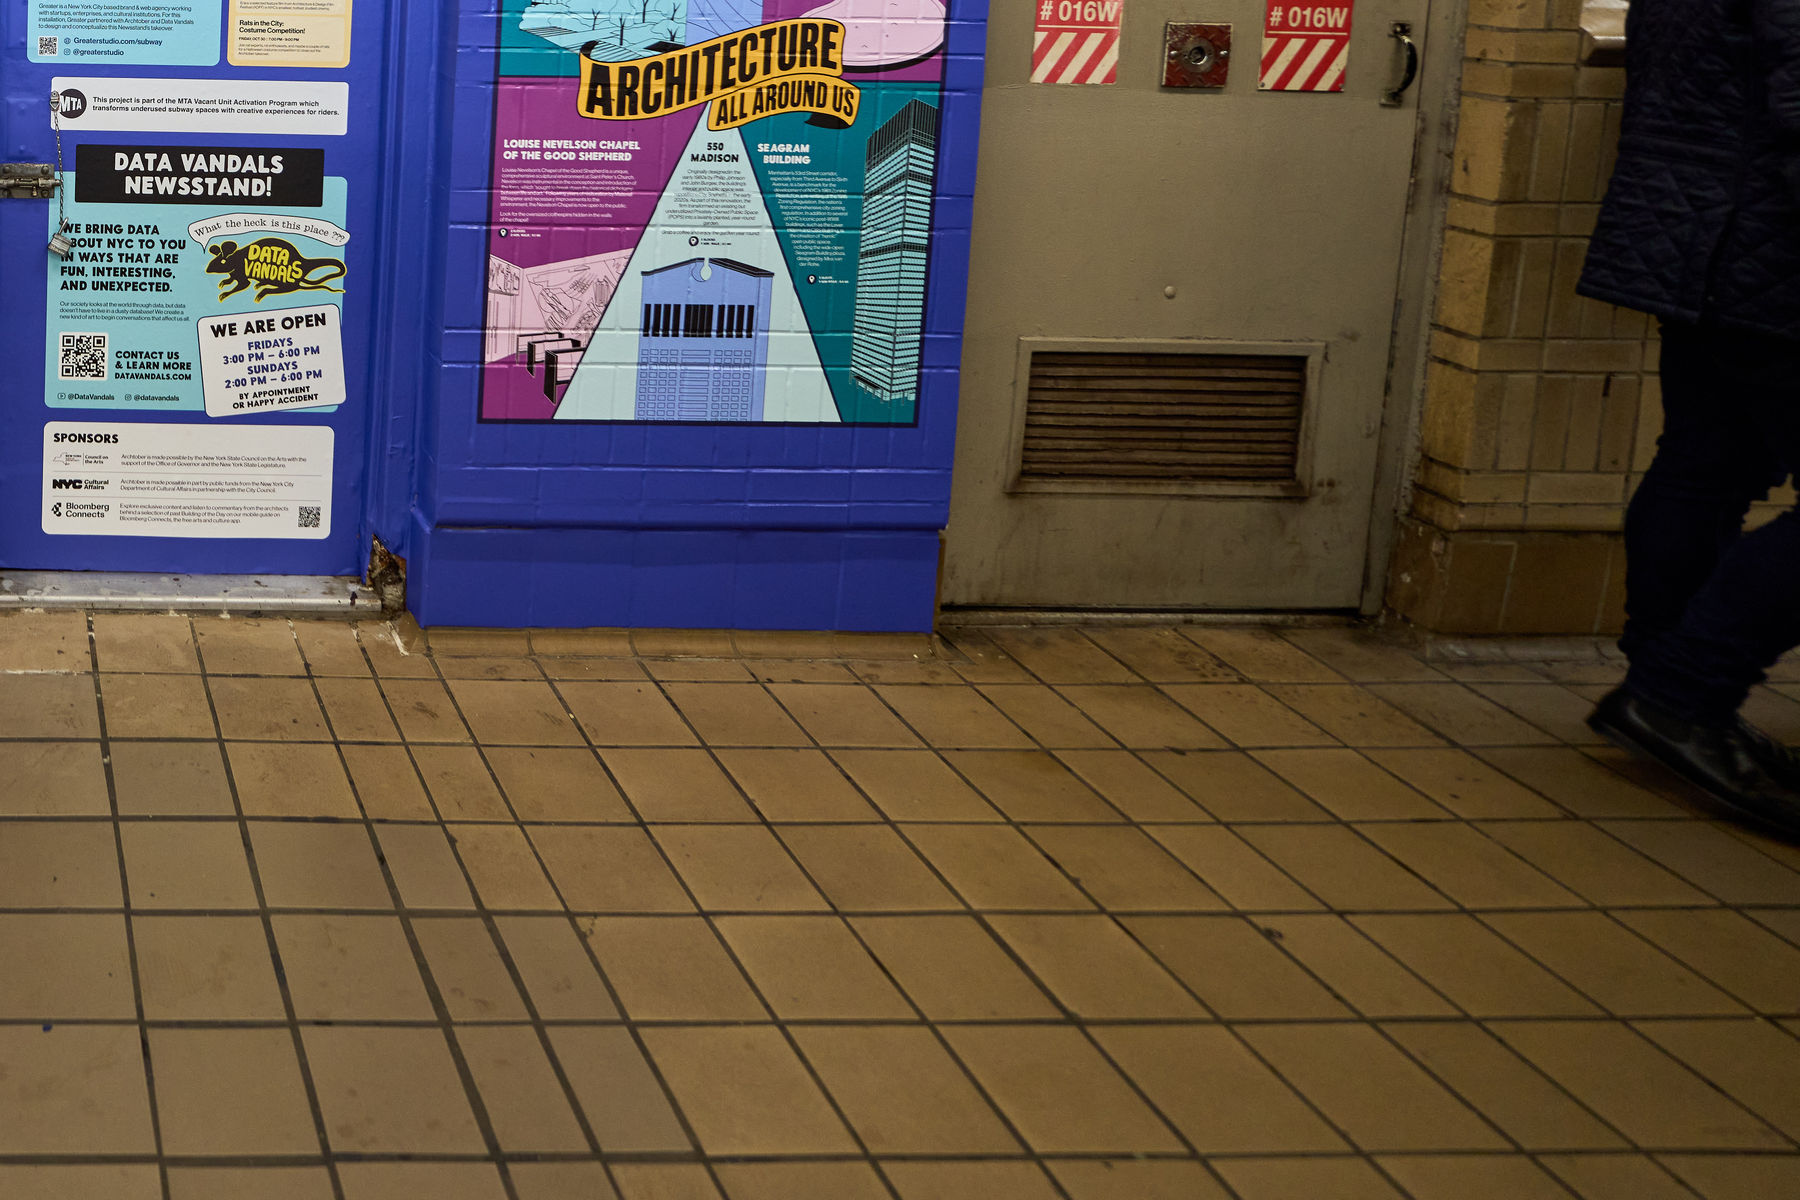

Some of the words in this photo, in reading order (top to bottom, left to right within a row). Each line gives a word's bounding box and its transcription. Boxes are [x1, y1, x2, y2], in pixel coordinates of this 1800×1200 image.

[1040, 0, 1054, 21] #
[1057, 0, 1118, 23] 016W
[1269, 6, 1283, 26] #
[1287, 6, 1348, 28] 016W
[584, 24, 839, 118] ARCHITECTURE
[714, 94, 750, 127] ALL
[751, 80, 827, 118] AROUND
[830, 83, 854, 116] US
[706, 142, 724, 152] 550
[757, 143, 810, 154] SEAGRAM
[114, 152, 173, 172] DATA
[180, 153, 284, 174] VANDALS
[690, 153, 739, 164] MADISON
[763, 154, 811, 165] BUILDING
[124, 176, 273, 197] NEWSSTAND!
[60, 266, 88, 279] FUN,
[92, 267, 176, 280] INTERESTING,
[60, 280, 88, 291] AND
[91, 280, 173, 293] UNEXPECTED.
[210, 323, 237, 338] WE
[243, 320, 276, 335] ARE
[280, 313, 327, 331] OPEN
[247, 337, 293, 350] FRIDAYS
[115, 351, 162, 360] CONTACT
[165, 351, 180, 360] US
[115, 360, 123, 370] &
[126, 361, 160, 370] LEARN
[162, 361, 192, 371] MORE
[247, 360, 298, 375] SUNDAYS
[114, 372, 192, 381] DATAVANDALS.COM
[53, 432, 119, 444] SPONSORS
